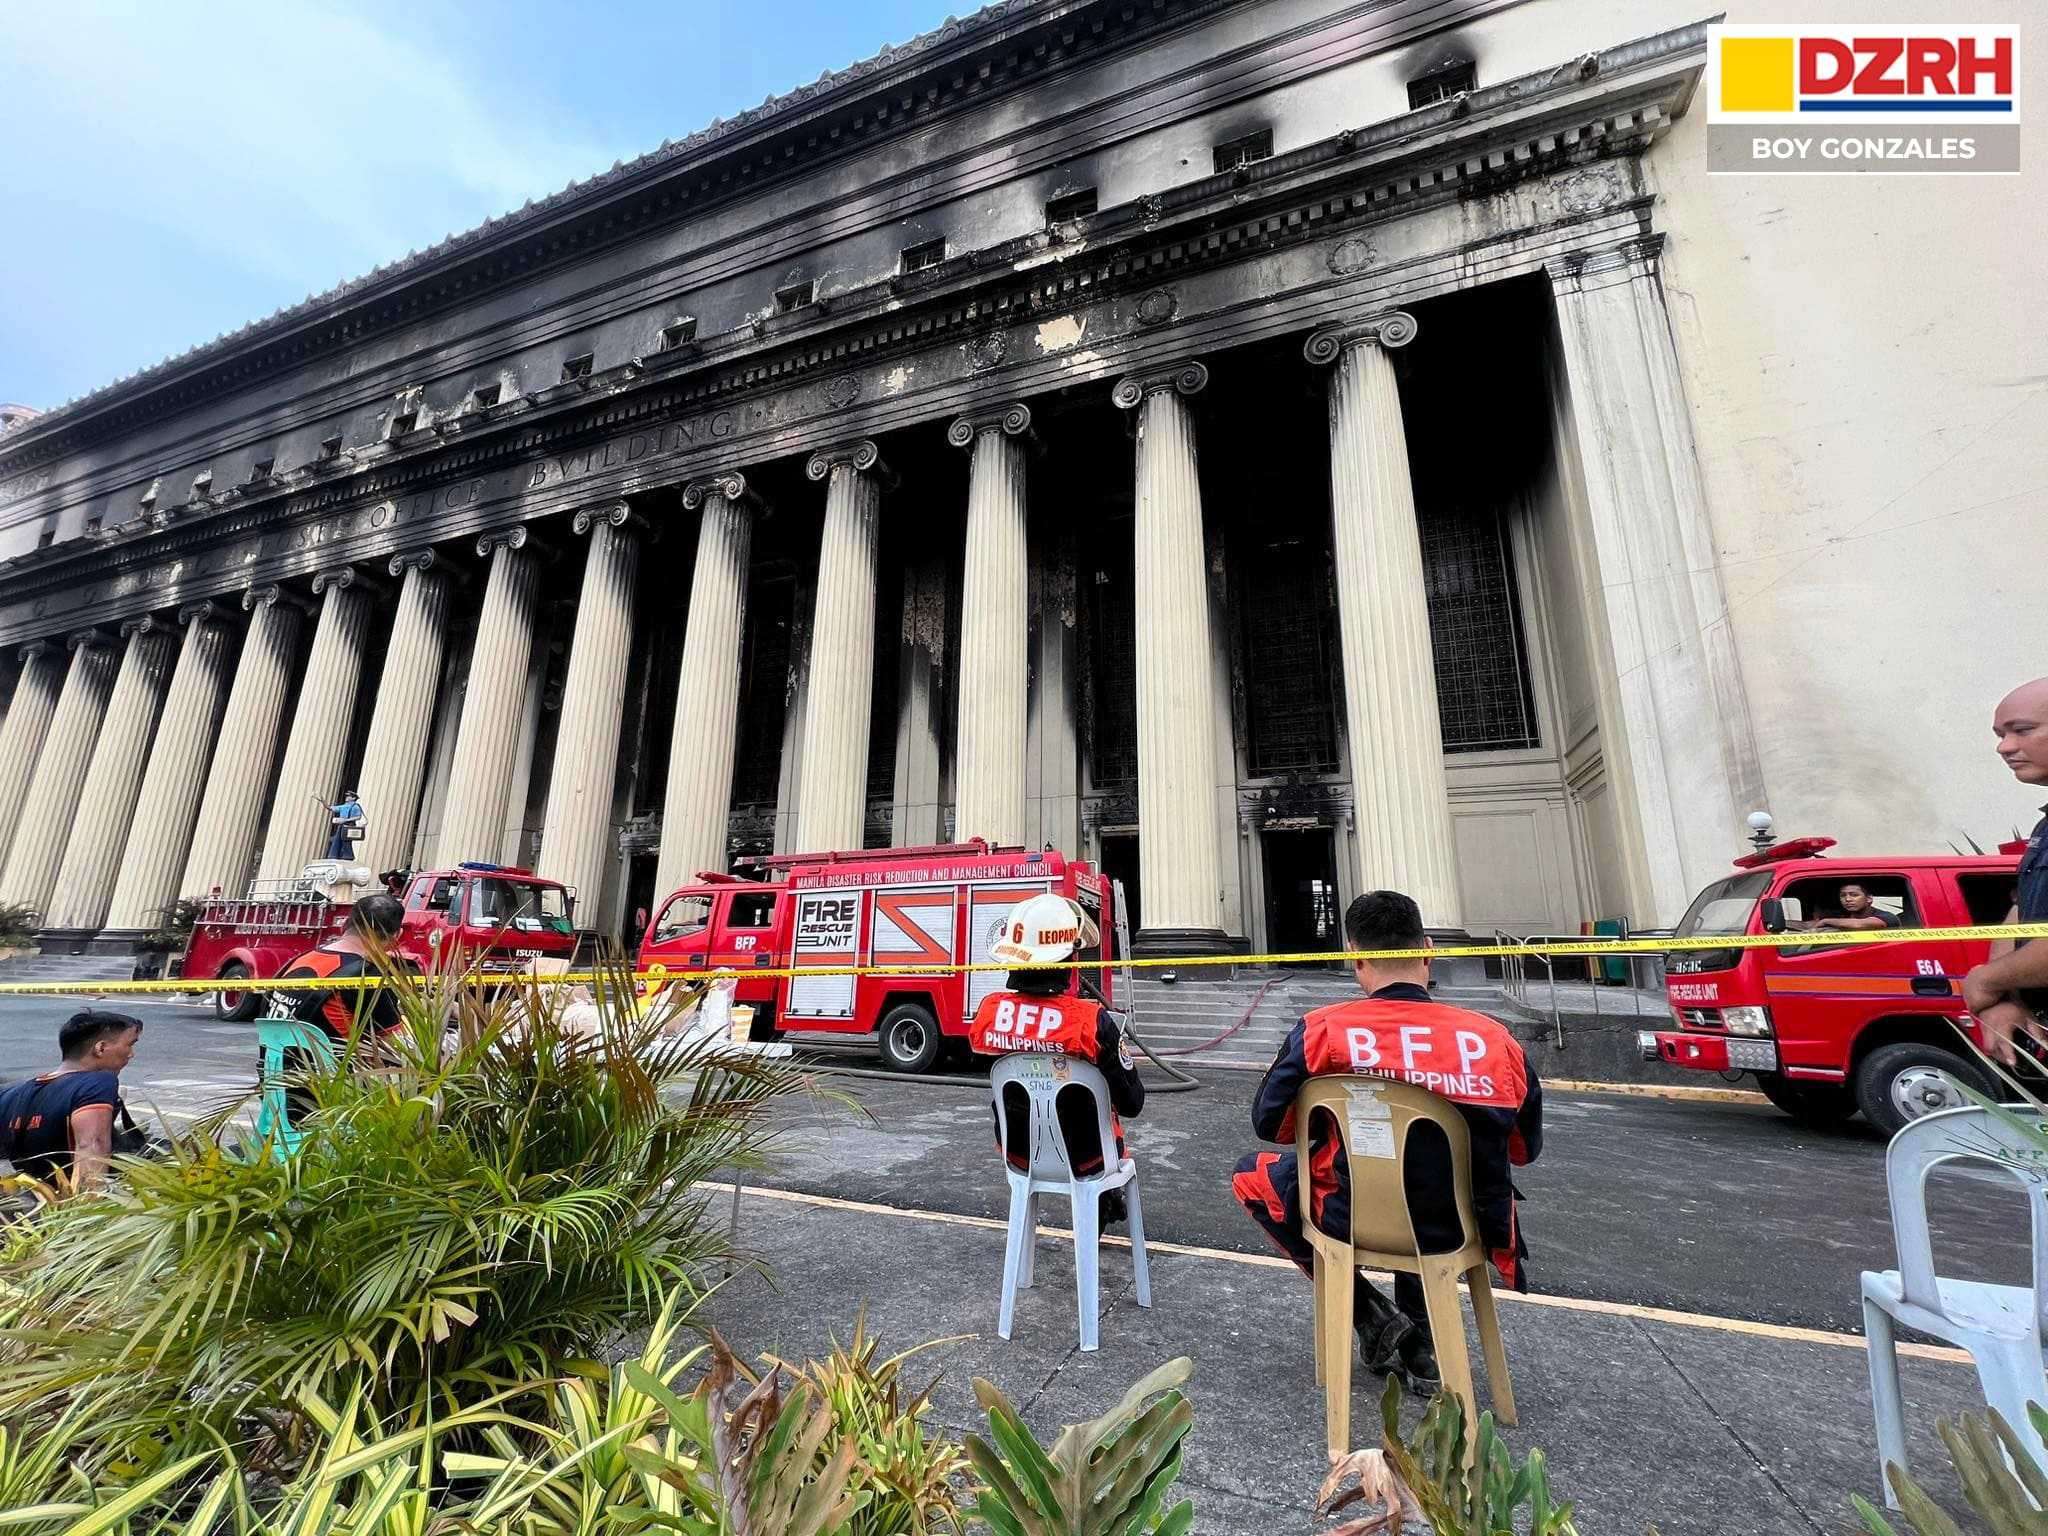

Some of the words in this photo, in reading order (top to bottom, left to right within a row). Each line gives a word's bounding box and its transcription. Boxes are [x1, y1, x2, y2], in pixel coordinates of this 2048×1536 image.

[370, 479, 484, 528] OFFICE
[796, 875, 824, 889] MANILA
[827, 873, 862, 887] DISASTER
[864, 872, 883, 884] RISK
[885, 868, 928, 883] REDUCTION
[932, 868, 949, 880] AND
[952, 864, 1011, 880] MANAGEMENT
[1014, 862, 1053, 876] COUNCIL
[802, 900, 856, 922] FIRE
[801, 924, 853, 933] RESCUE
[1013, 922, 1024, 944] 6
[1872, 931, 1917, 940] UNDER
[1919, 926, 2018, 938] INVESTIGATION
[2017, 926, 2037, 934] BY
[735, 936, 756, 950] BFP
[813, 935, 852, 947] UNIT
[1657, 938, 1694, 947] UNDER
[1696, 935, 1781, 946] INVESTIGATION
[1783, 935, 1798, 943] BY
[1801, 933, 1853, 942] BFP-NCR
[516, 949, 543, 957] ISUZU
[994, 1001, 1063, 1038] BFP
[985, 1032, 1065, 1053] PHILIPPINES
